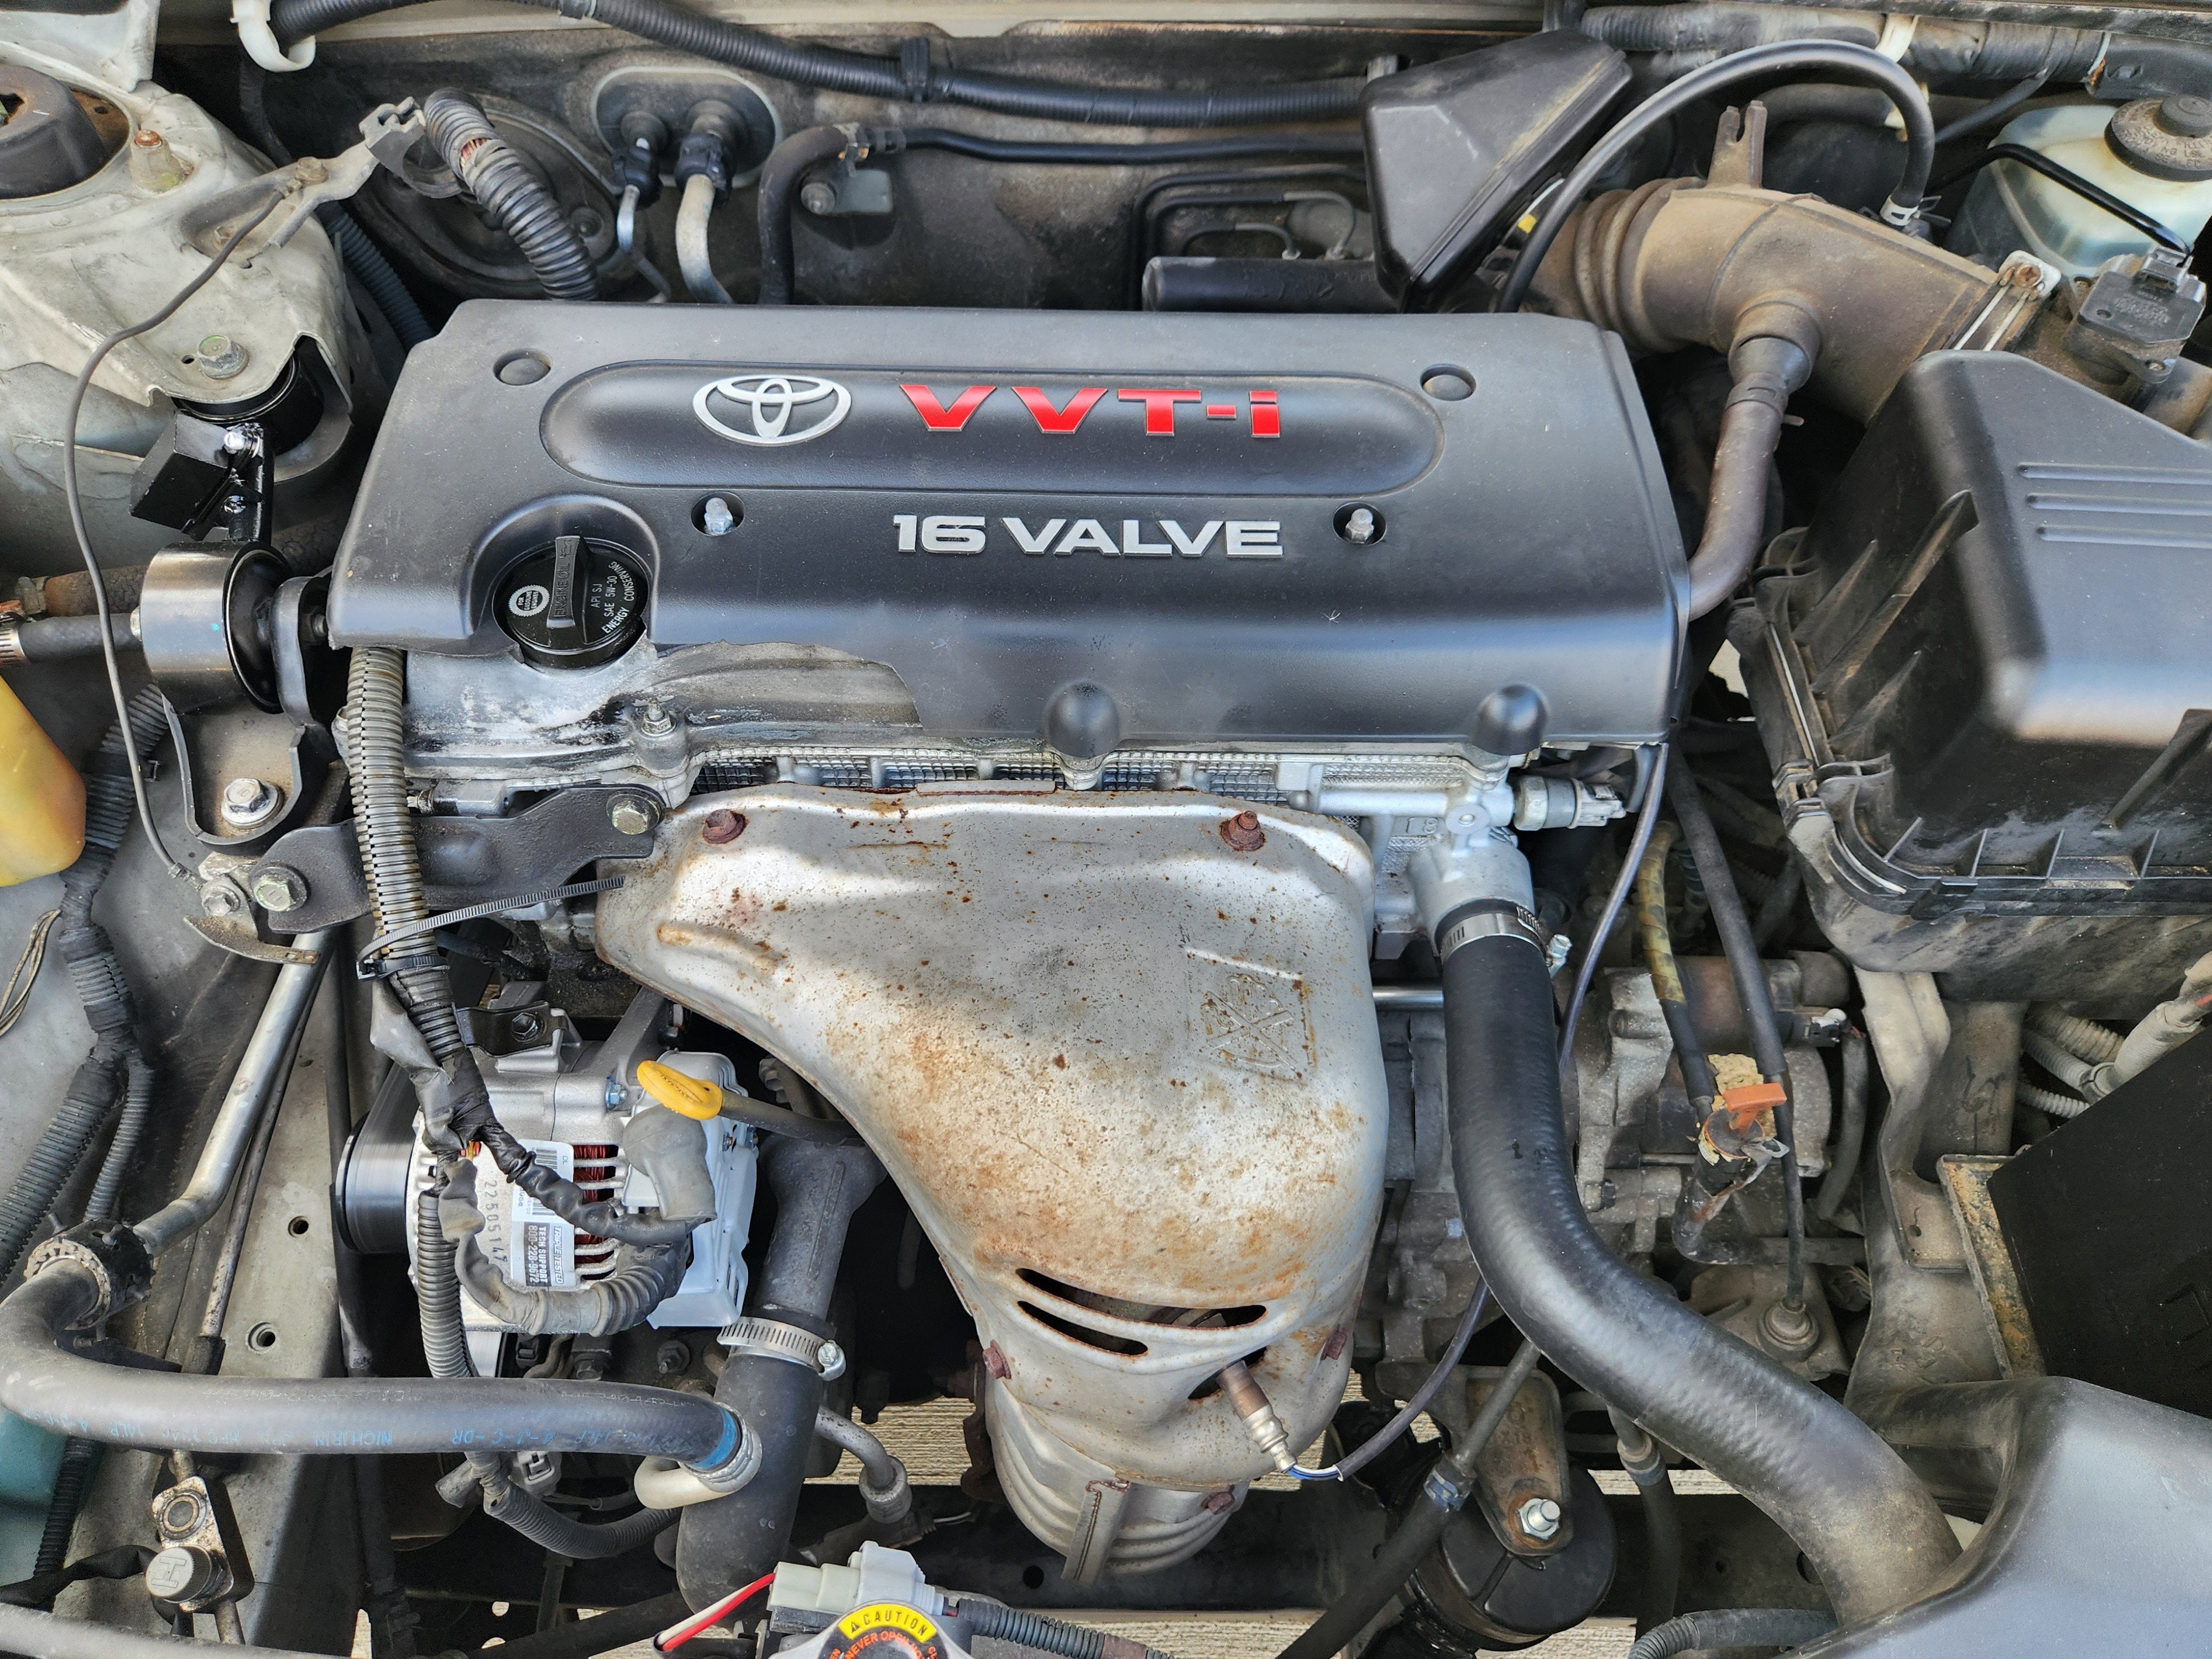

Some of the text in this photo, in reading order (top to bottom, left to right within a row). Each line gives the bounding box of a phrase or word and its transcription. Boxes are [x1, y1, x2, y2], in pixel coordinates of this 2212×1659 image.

[900, 384, 1281, 438] VVT-i
[893, 515, 1284, 558] 16 VALVE
[554, 562, 570, 618] ENGINE OIL
[591, 583, 603, 608] API SJ
[601, 560, 635, 634] ENERGY CONSERVING
[603, 575, 618, 617] SAE 5W-30
[1406, 817, 1438, 834] 18
[528, 1225, 540, 1283] 800-228-9672
[538, 1227, 548, 1284] TECH SUPPORT
[554, 1225, 564, 1284] TRIPLE TESTED
[844, 1631, 879, 1659] NEVER
[880, 1630, 910, 1646] OPEN
[862, 1610, 928, 1636] CAUTION
